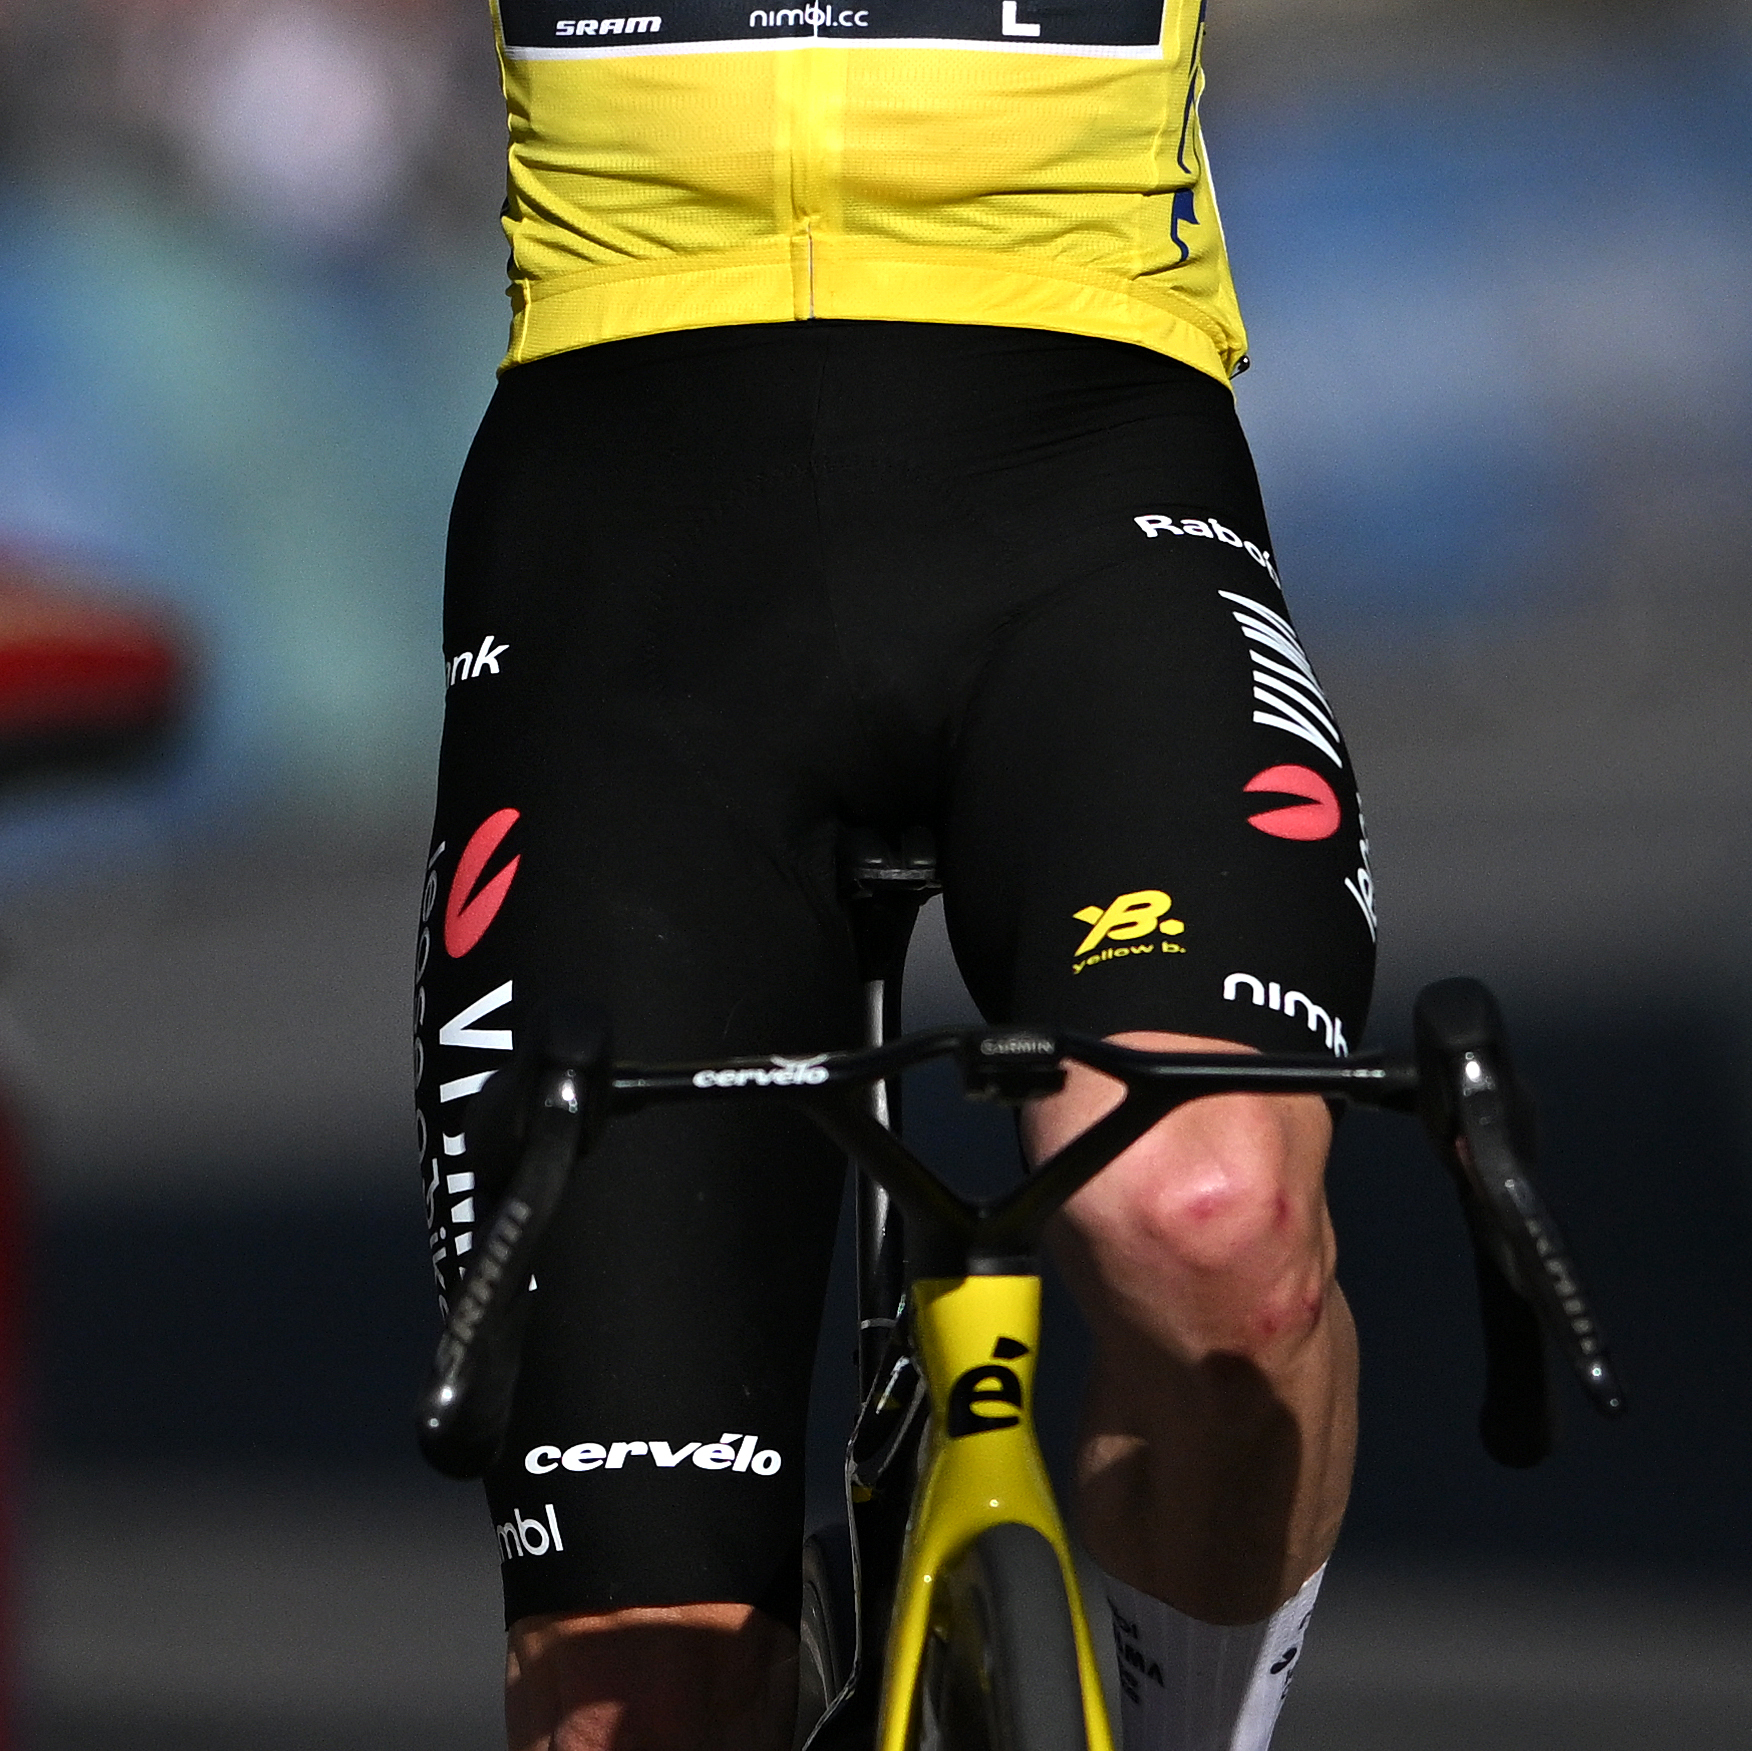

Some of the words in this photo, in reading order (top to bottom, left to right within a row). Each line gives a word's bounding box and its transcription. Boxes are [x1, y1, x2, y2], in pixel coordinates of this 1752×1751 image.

[555, 16, 662, 36] SRAM
[749, 3, 870, 27] nimbl.cc
[1002, 0, 1041, 37] L
[1072, 944, 1155, 975] yellow
[1161, 941, 1187, 954] b.
[524, 1433, 783, 1476] cervélo
